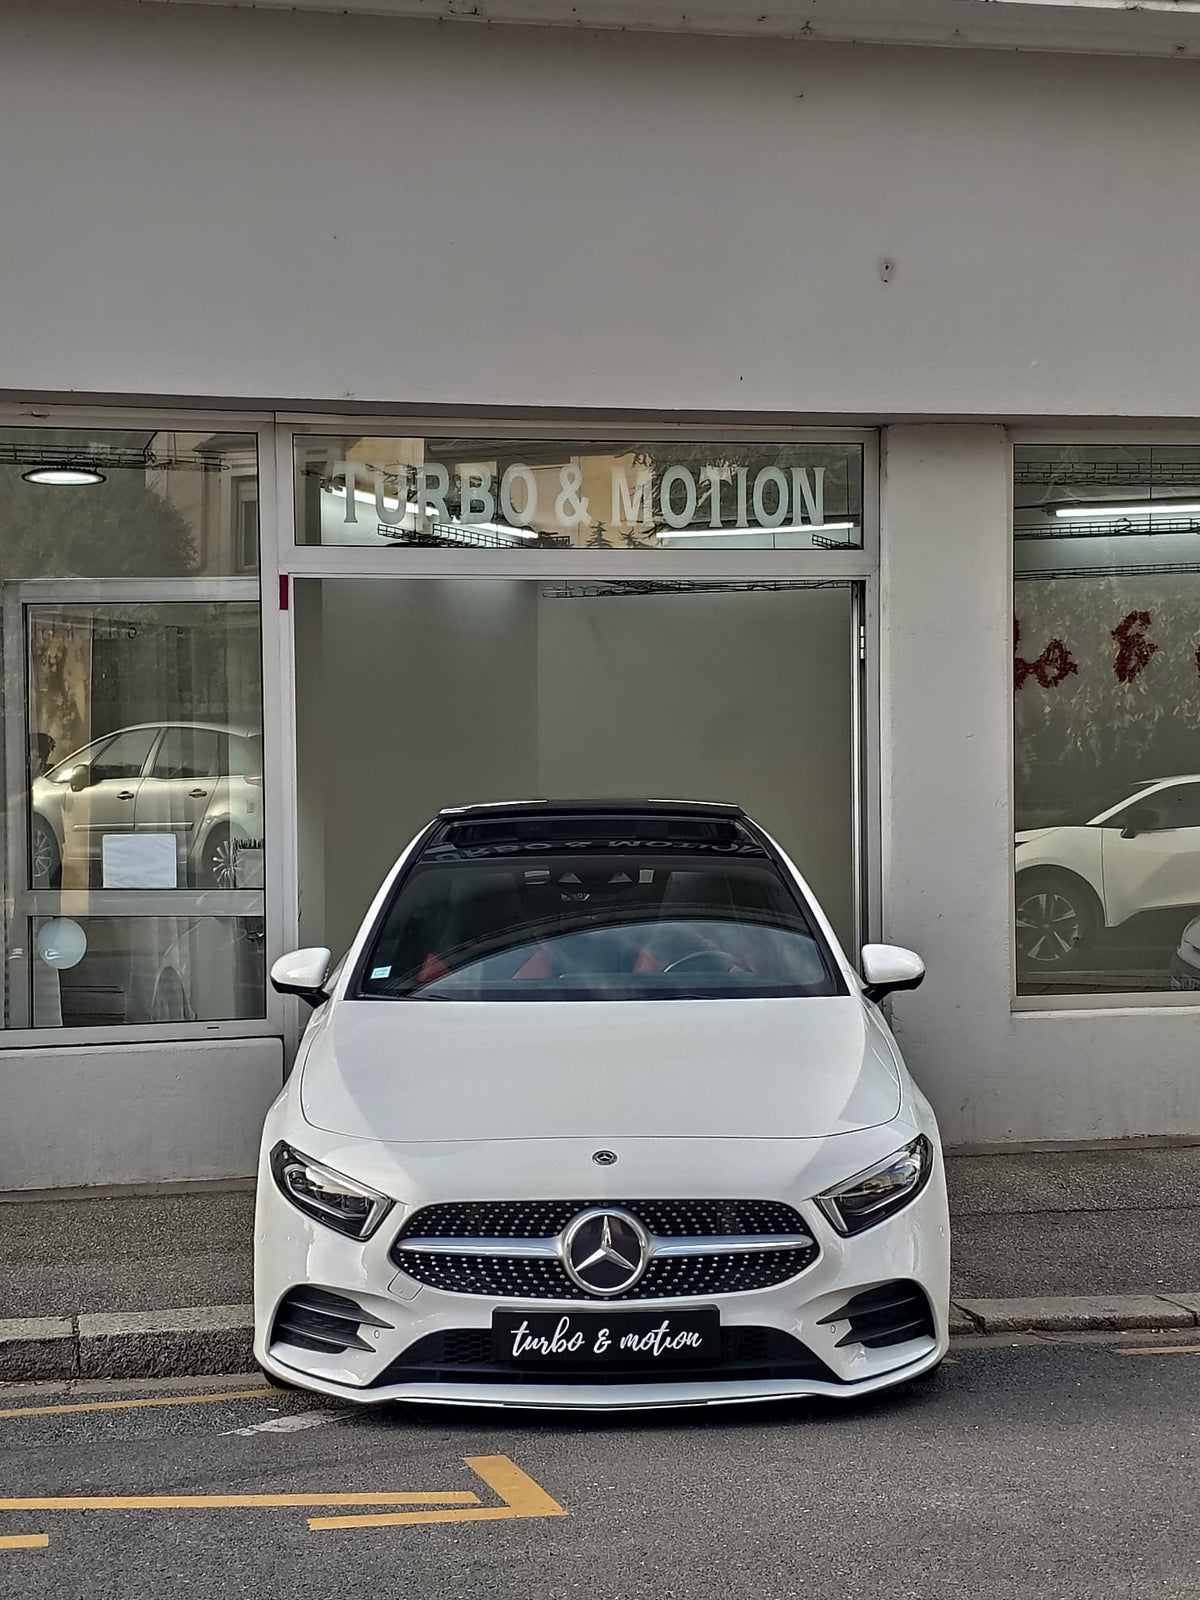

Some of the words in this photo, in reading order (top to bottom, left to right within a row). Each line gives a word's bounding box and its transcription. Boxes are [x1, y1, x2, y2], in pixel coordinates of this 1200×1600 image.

[335, 461, 538, 527] TURBO
[554, 464, 592, 527] &
[610, 465, 826, 528] MOTION
[510, 1316, 585, 1357] turbo
[593, 1328, 612, 1354] &
[620, 1320, 703, 1357] motion
